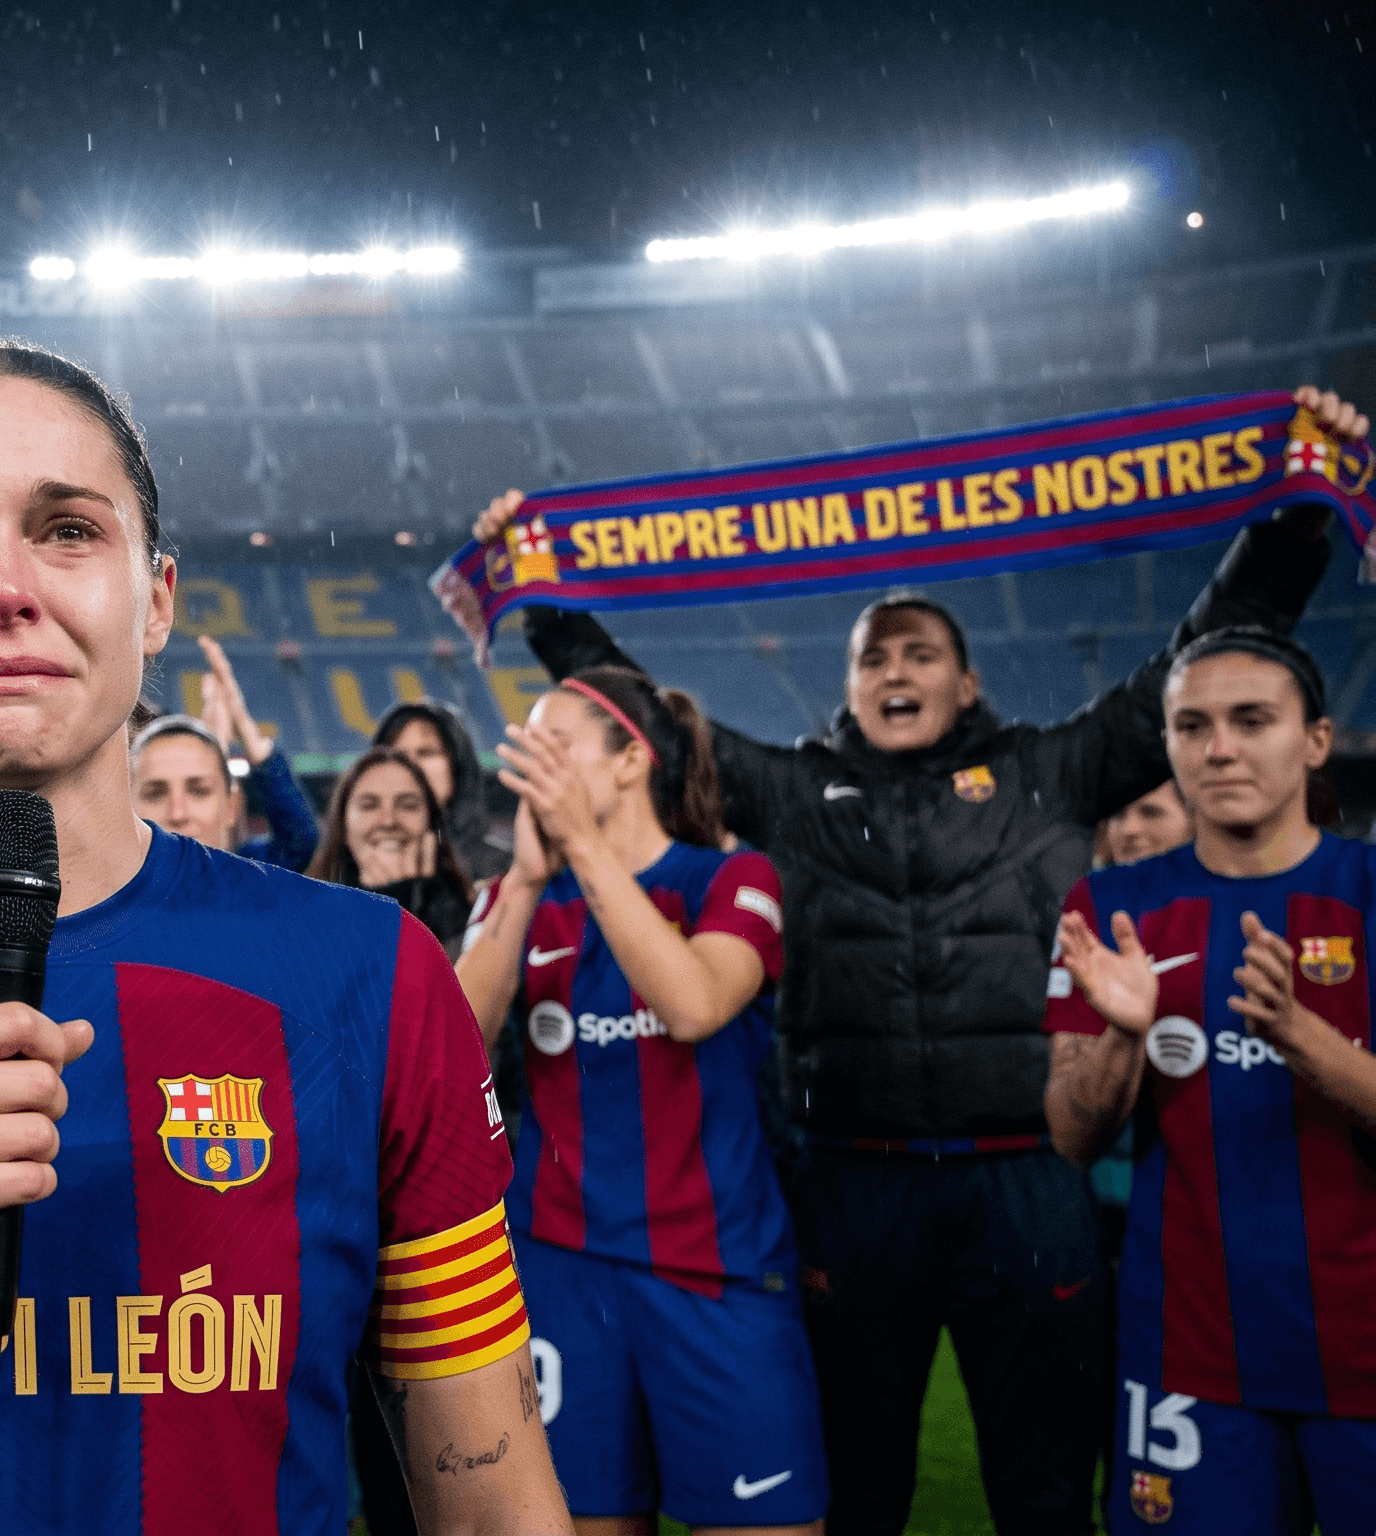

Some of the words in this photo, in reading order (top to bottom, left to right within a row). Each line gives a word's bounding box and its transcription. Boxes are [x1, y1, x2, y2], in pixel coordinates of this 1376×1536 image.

[570, 506, 746, 569] SEMPRE
[752, 493, 856, 553] UNA
[863, 482, 930, 541] DE
[936, 469, 1025, 532] LES
[1032, 426, 1266, 518] NOSTRES
[578, 1008, 667, 1048] Spoti
[194, 1123, 237, 1137] FCB
[68, 1263, 283, 1395] LEÓN
